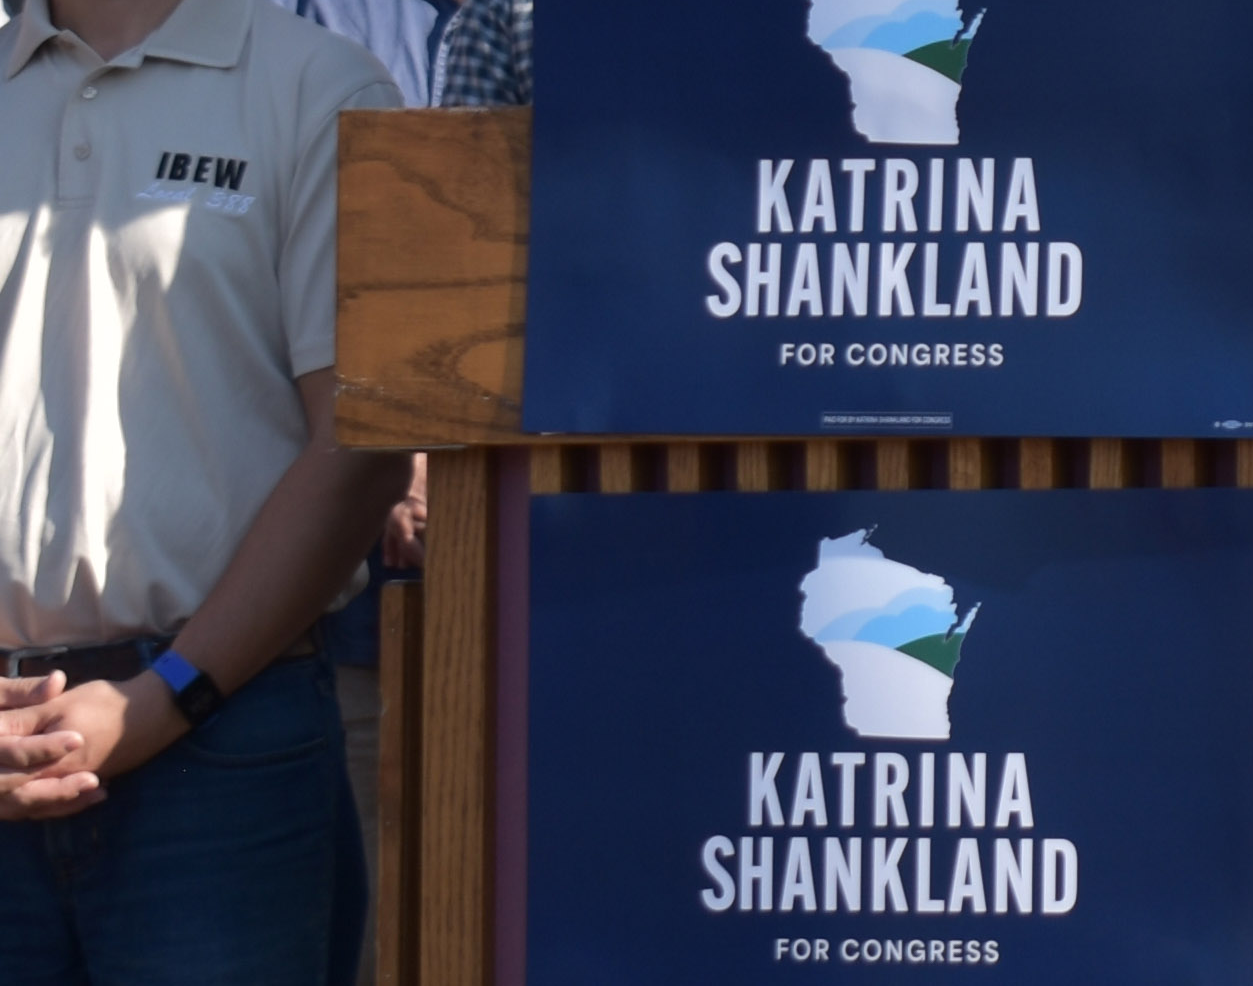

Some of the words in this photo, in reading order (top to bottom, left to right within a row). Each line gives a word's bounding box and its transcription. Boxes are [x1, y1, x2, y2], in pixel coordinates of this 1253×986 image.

[155, 150, 248, 191] IBEW
[757, 157, 1041, 233] KATRINA
[706, 241, 1083, 318] SHANKLAND
[780, 343, 835, 367] FOR
[845, 342, 1004, 367] CONGRESS
[749, 752, 1034, 828] KATRINA
[702, 835, 1078, 914] SHANKLAND
[776, 938, 830, 963] FOR
[840, 938, 1000, 964] CONGRESS
